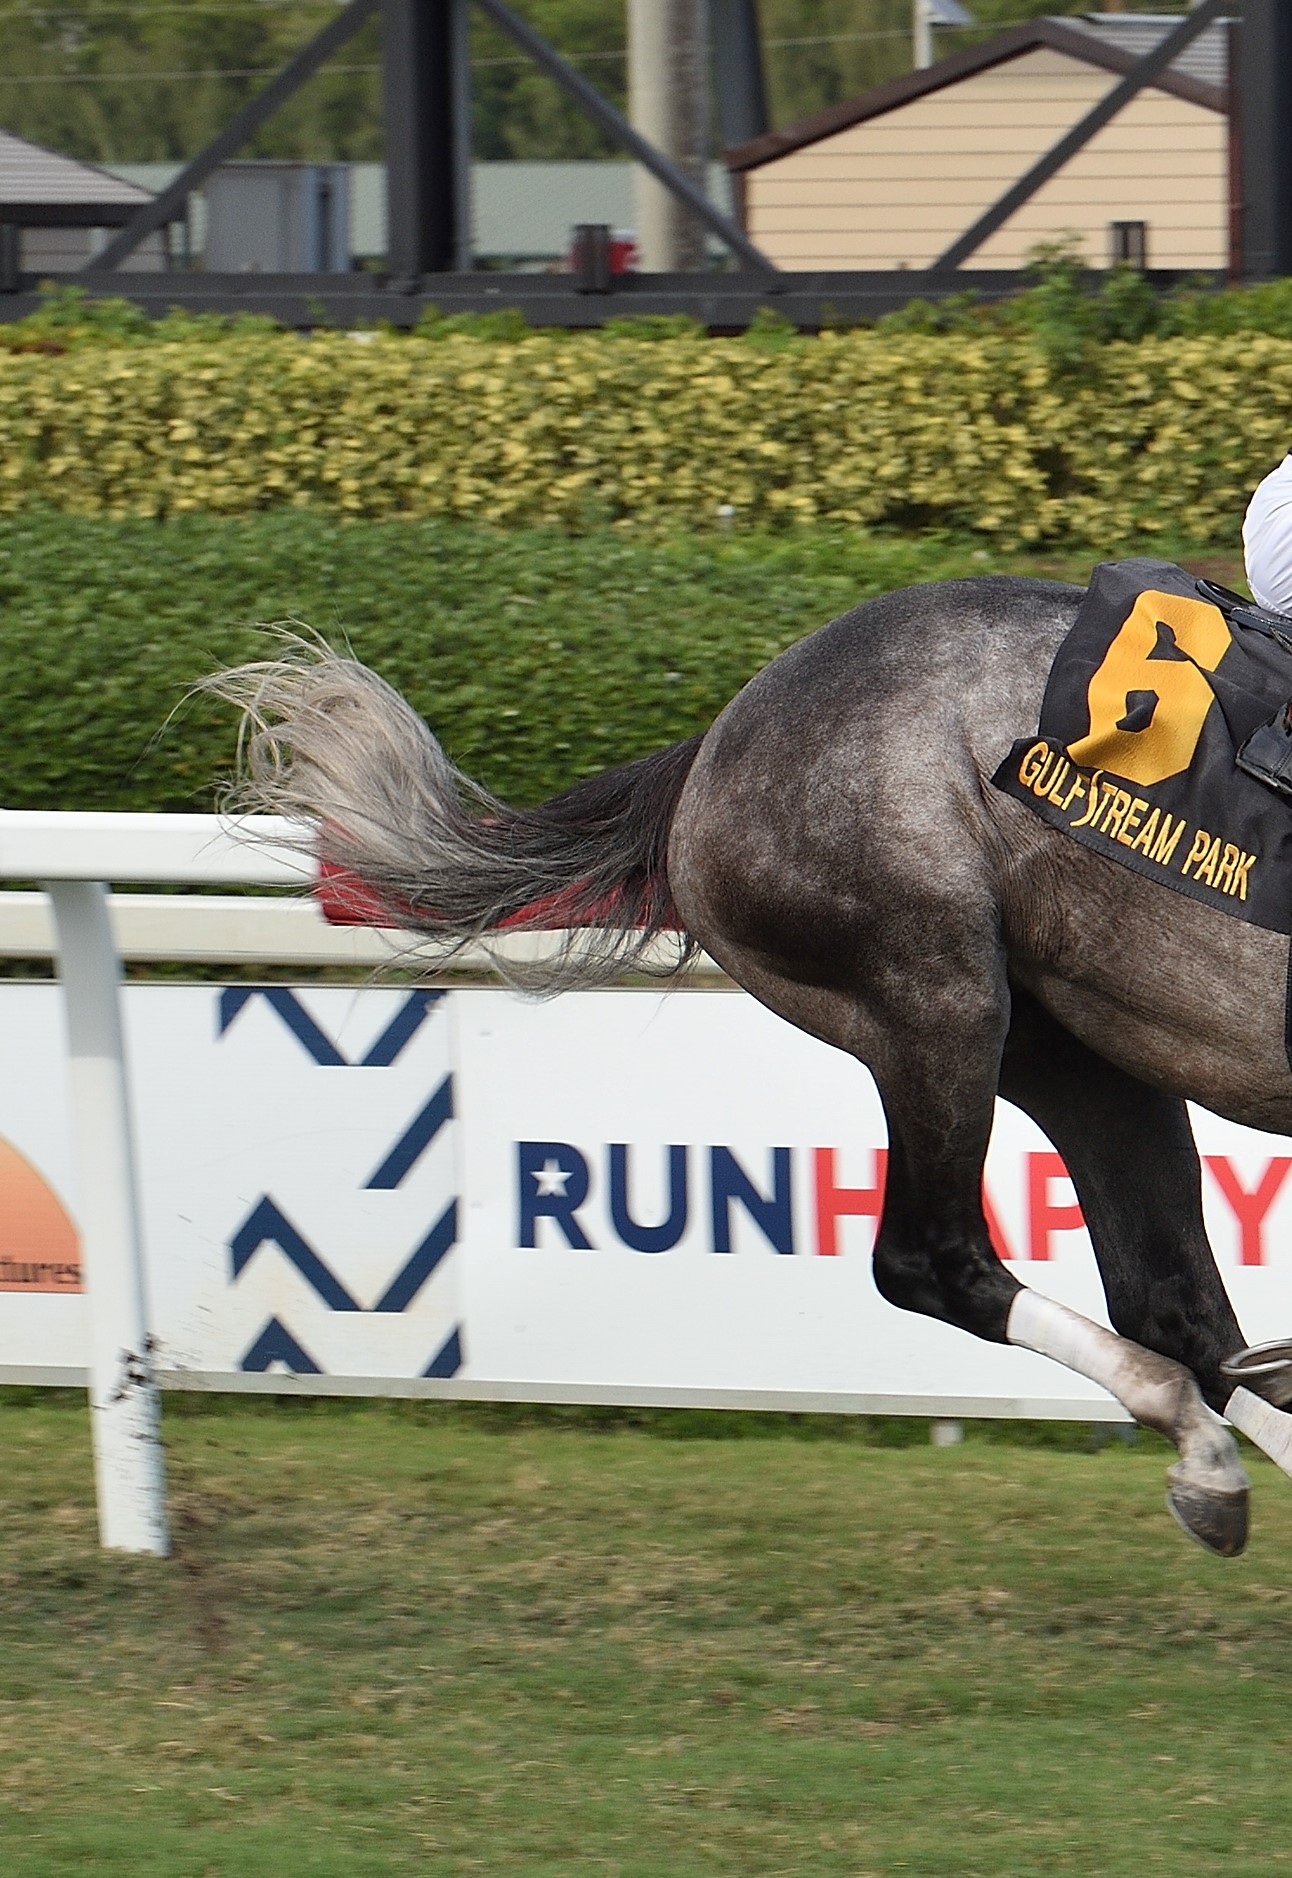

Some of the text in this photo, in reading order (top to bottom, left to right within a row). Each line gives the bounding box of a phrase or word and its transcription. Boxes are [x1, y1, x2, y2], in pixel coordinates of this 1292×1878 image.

[1066, 589, 1232, 787] 6
[1018, 741, 1257, 901] GULFSTREAM PARK
